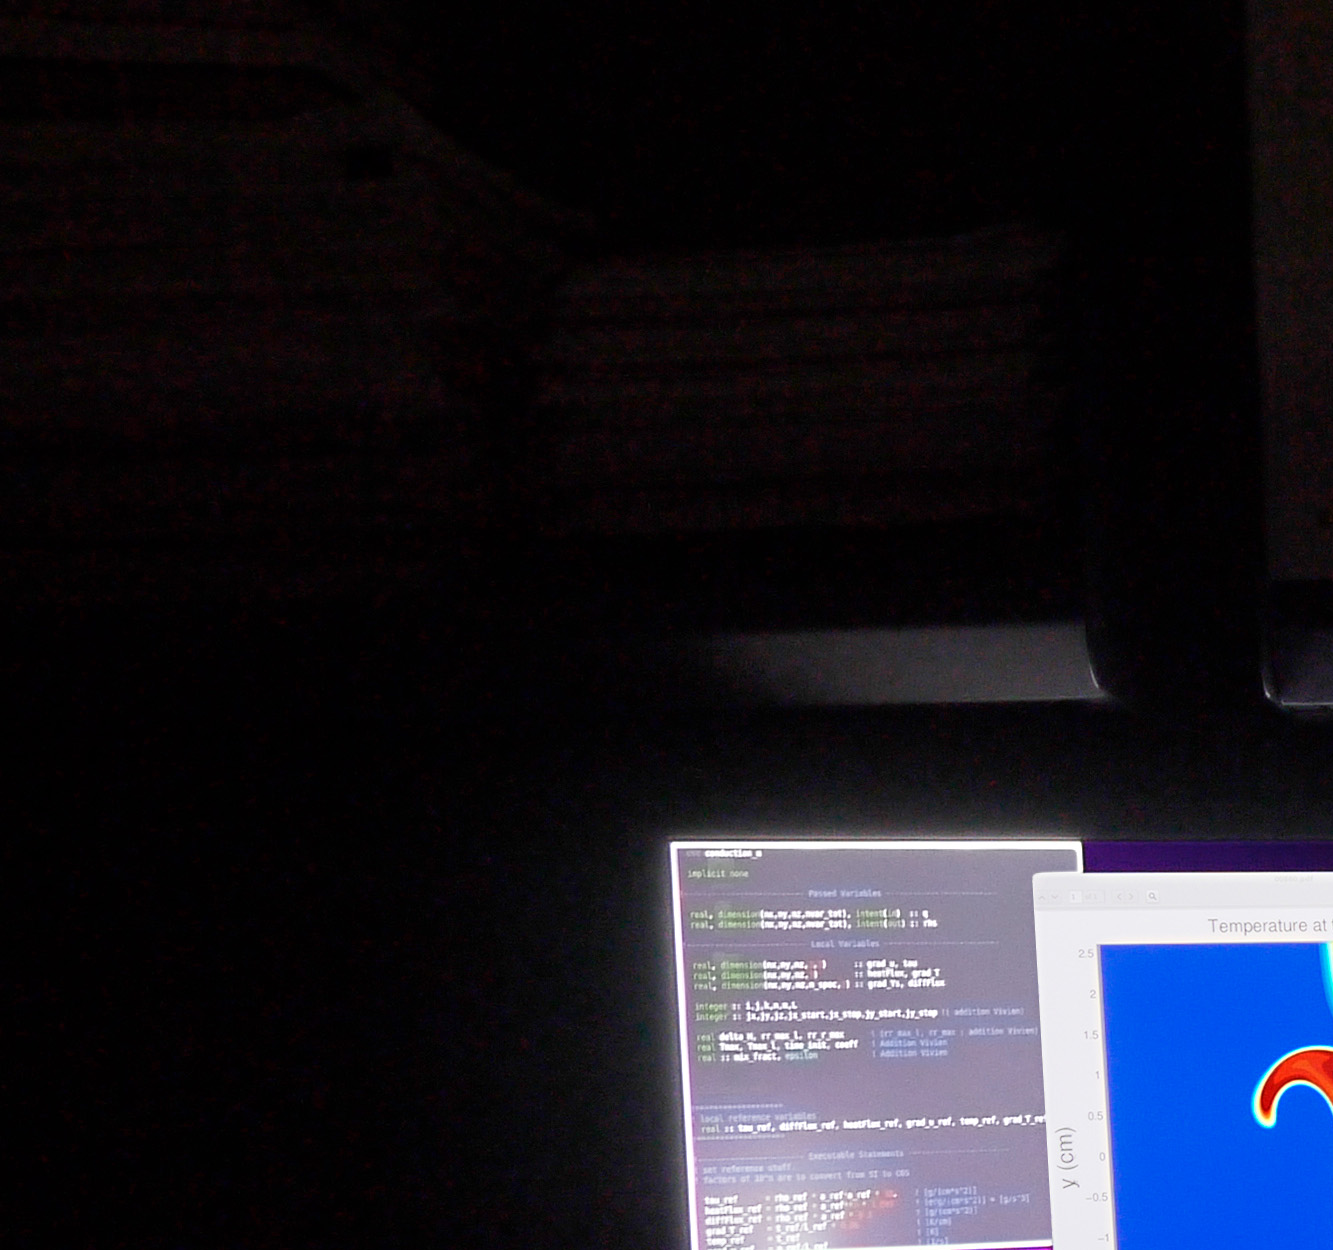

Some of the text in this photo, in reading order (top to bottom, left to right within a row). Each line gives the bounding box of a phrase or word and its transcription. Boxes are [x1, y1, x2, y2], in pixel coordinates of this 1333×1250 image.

[687, 869, 749, 878] implicit none
[1208, 917, 1308, 936] Temperature
[1312, 917, 1328, 931] at
[1078, 949, 1095, 959] 2.5
[1089, 989, 1097, 999] 2
[1084, 1030, 1099, 1040] 1.5
[1087, 1111, 1104, 1121] 0.5
[1054, 1127, 1080, 1189] y (cm)
[1099, 1152, 1106, 1162] 0
[1085, 1192, 1109, 1202] -0.5
[1098, 1233, 1110, 1243] -1
